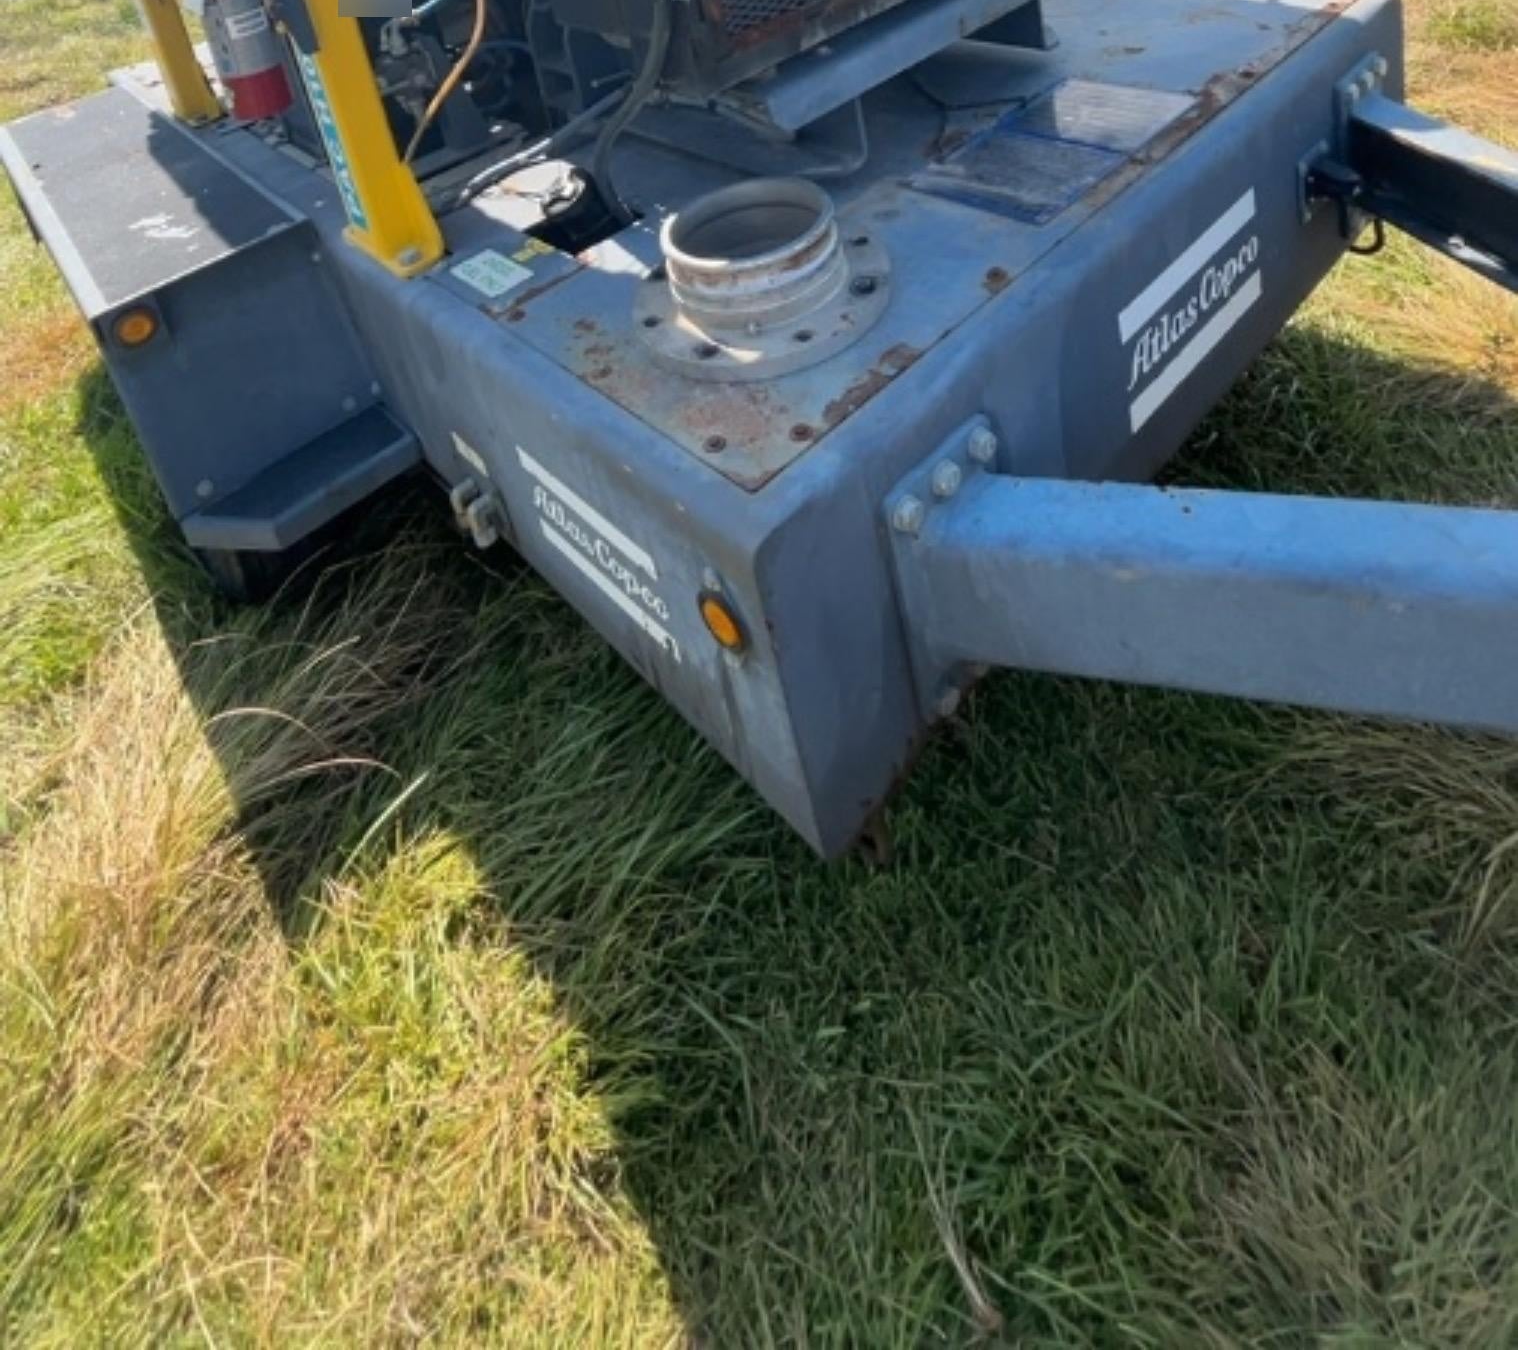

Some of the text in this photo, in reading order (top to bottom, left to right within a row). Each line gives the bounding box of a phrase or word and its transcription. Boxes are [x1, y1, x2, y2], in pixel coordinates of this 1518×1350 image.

[1127, 236, 1259, 392] Atlas Copco
[533, 484, 670, 622] Atlas Copco
